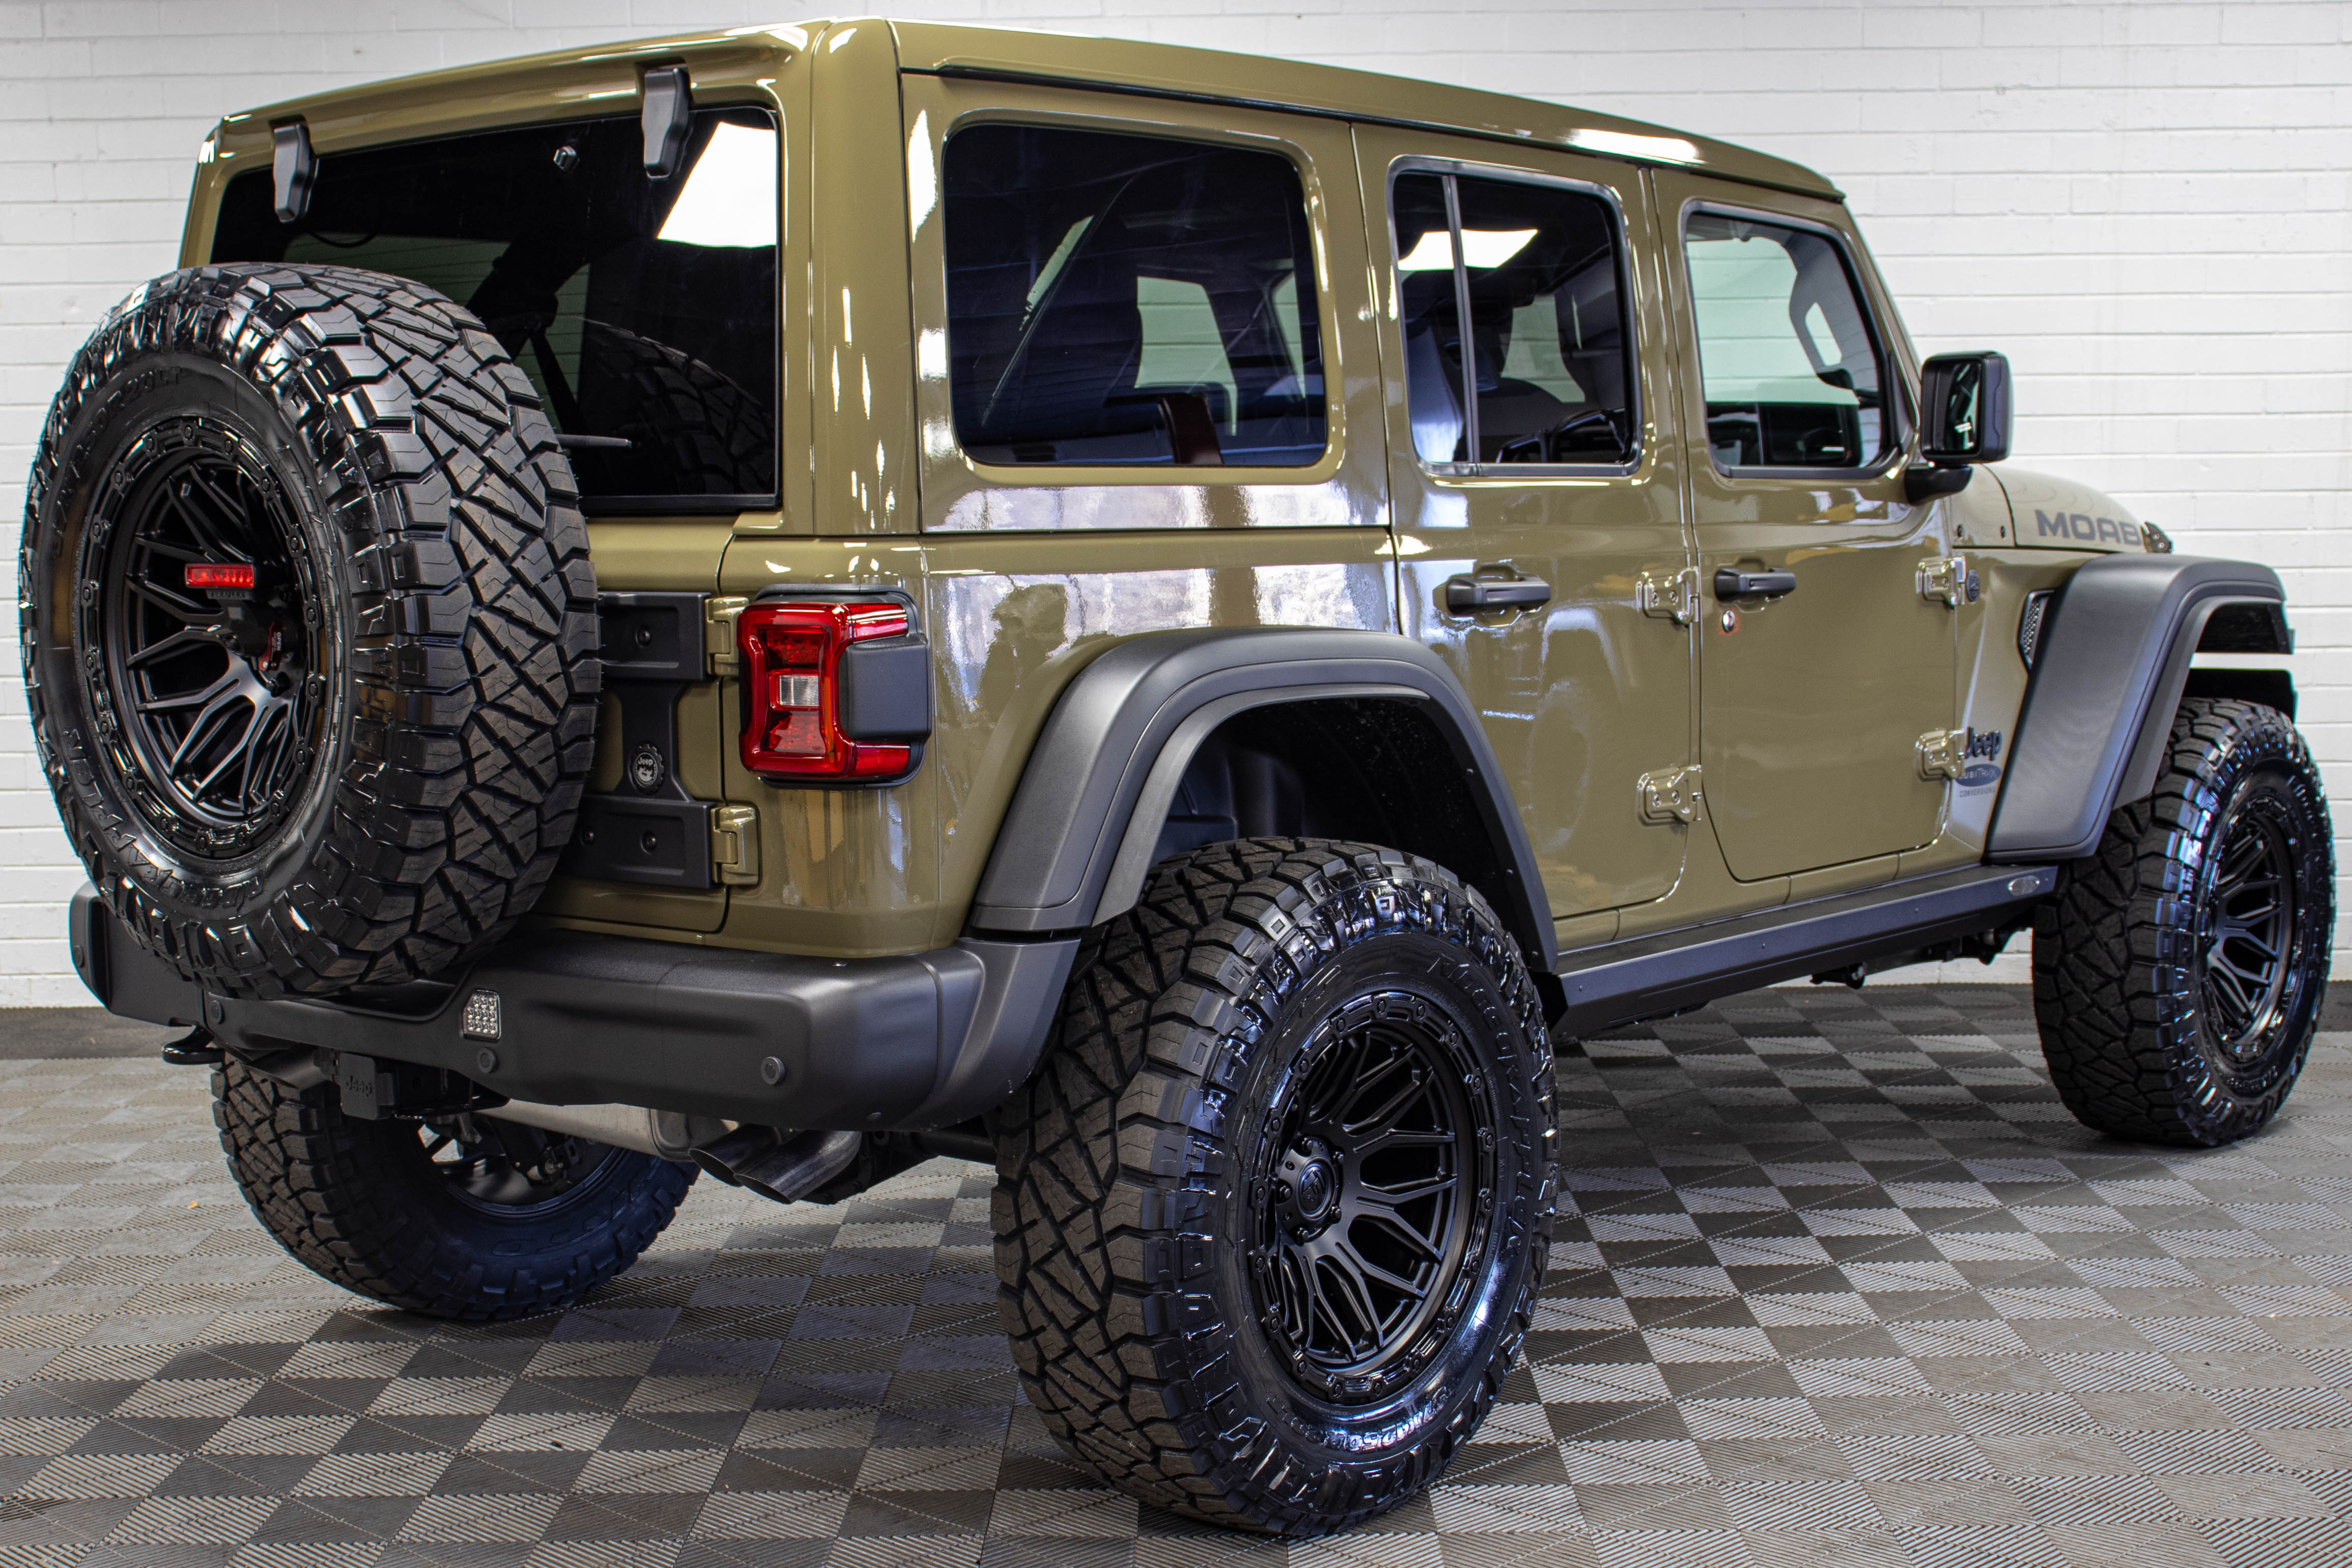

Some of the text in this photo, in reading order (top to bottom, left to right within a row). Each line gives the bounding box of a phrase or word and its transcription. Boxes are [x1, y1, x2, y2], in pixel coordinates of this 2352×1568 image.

[2034, 509, 2142, 546] MOAB
[1965, 726, 2002, 761] Jeep
[637, 757, 654, 766] Jeep
[1960, 767, 1997, 780] UBITRUX
[1960, 787, 1996, 797] CONVERSIONS
[346, 1074, 373, 1097] Jeep
